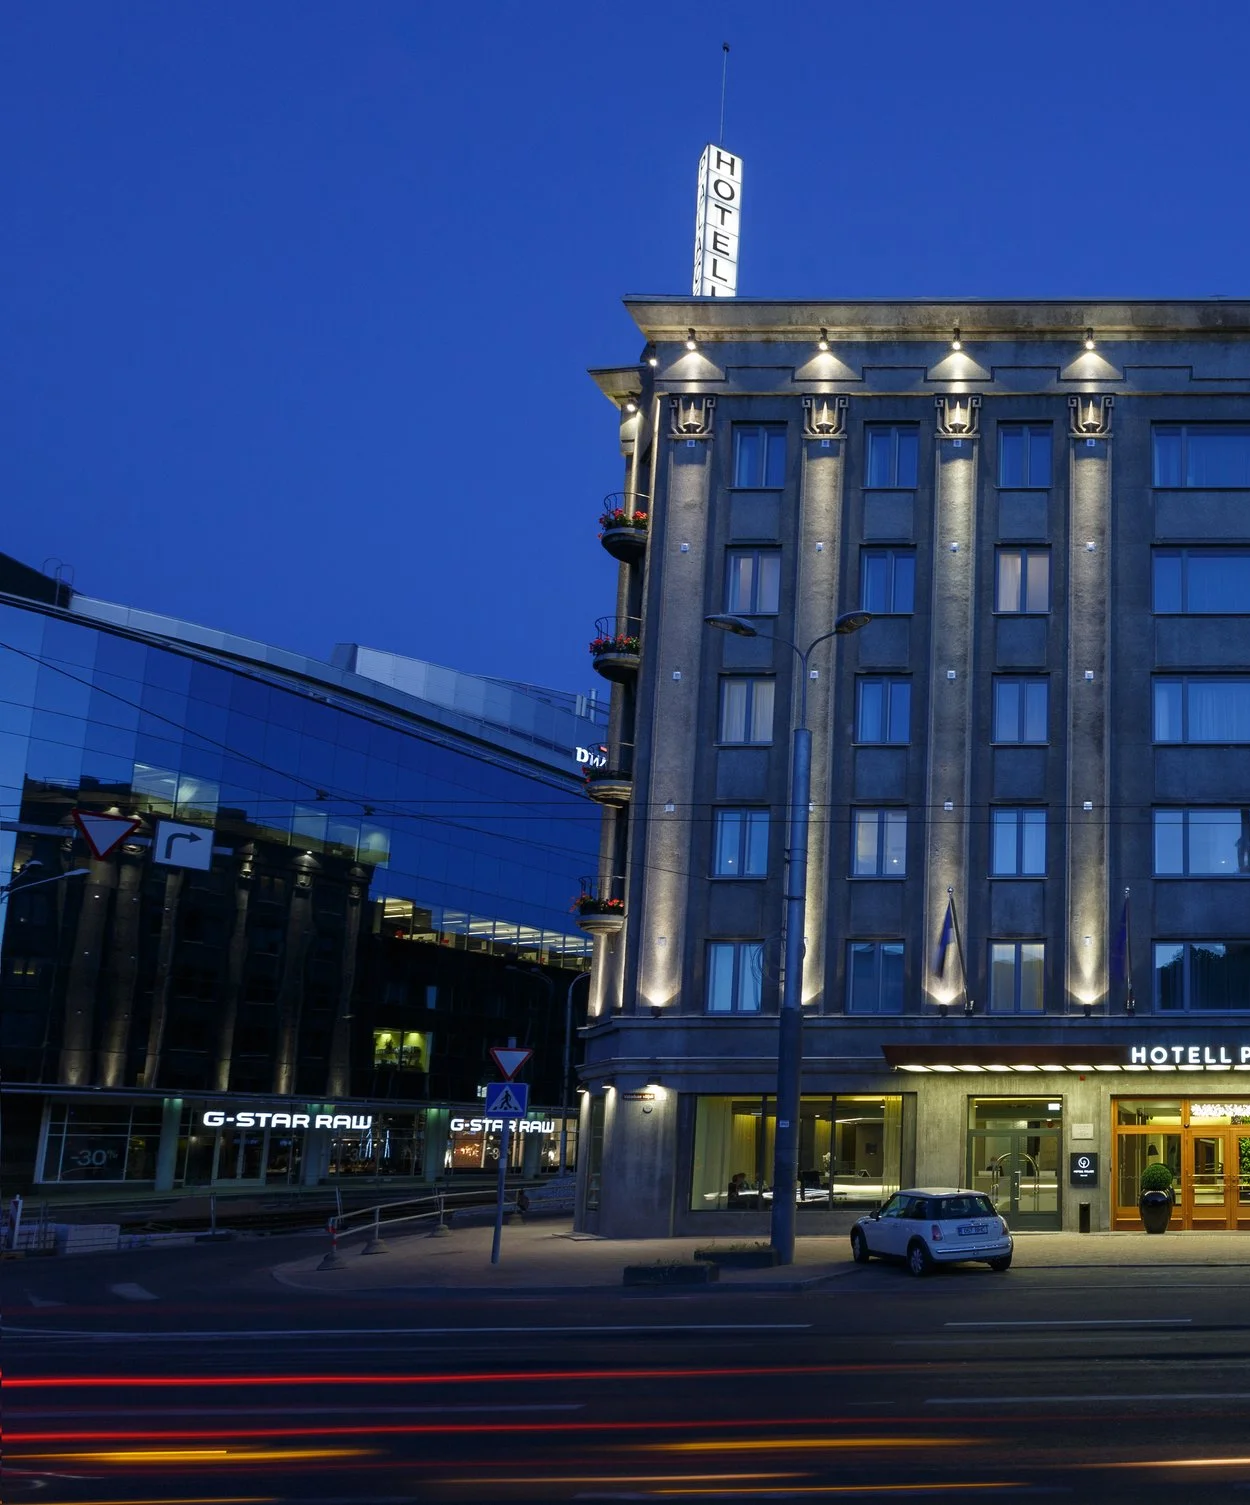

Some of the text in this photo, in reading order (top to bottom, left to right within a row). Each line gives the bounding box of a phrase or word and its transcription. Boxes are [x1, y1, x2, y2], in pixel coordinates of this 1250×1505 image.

[1131, 1046, 1232, 1064] HOTELL
[202, 1111, 373, 1130] G-STAR RAW
[518, 1120, 555, 1134] RAW
